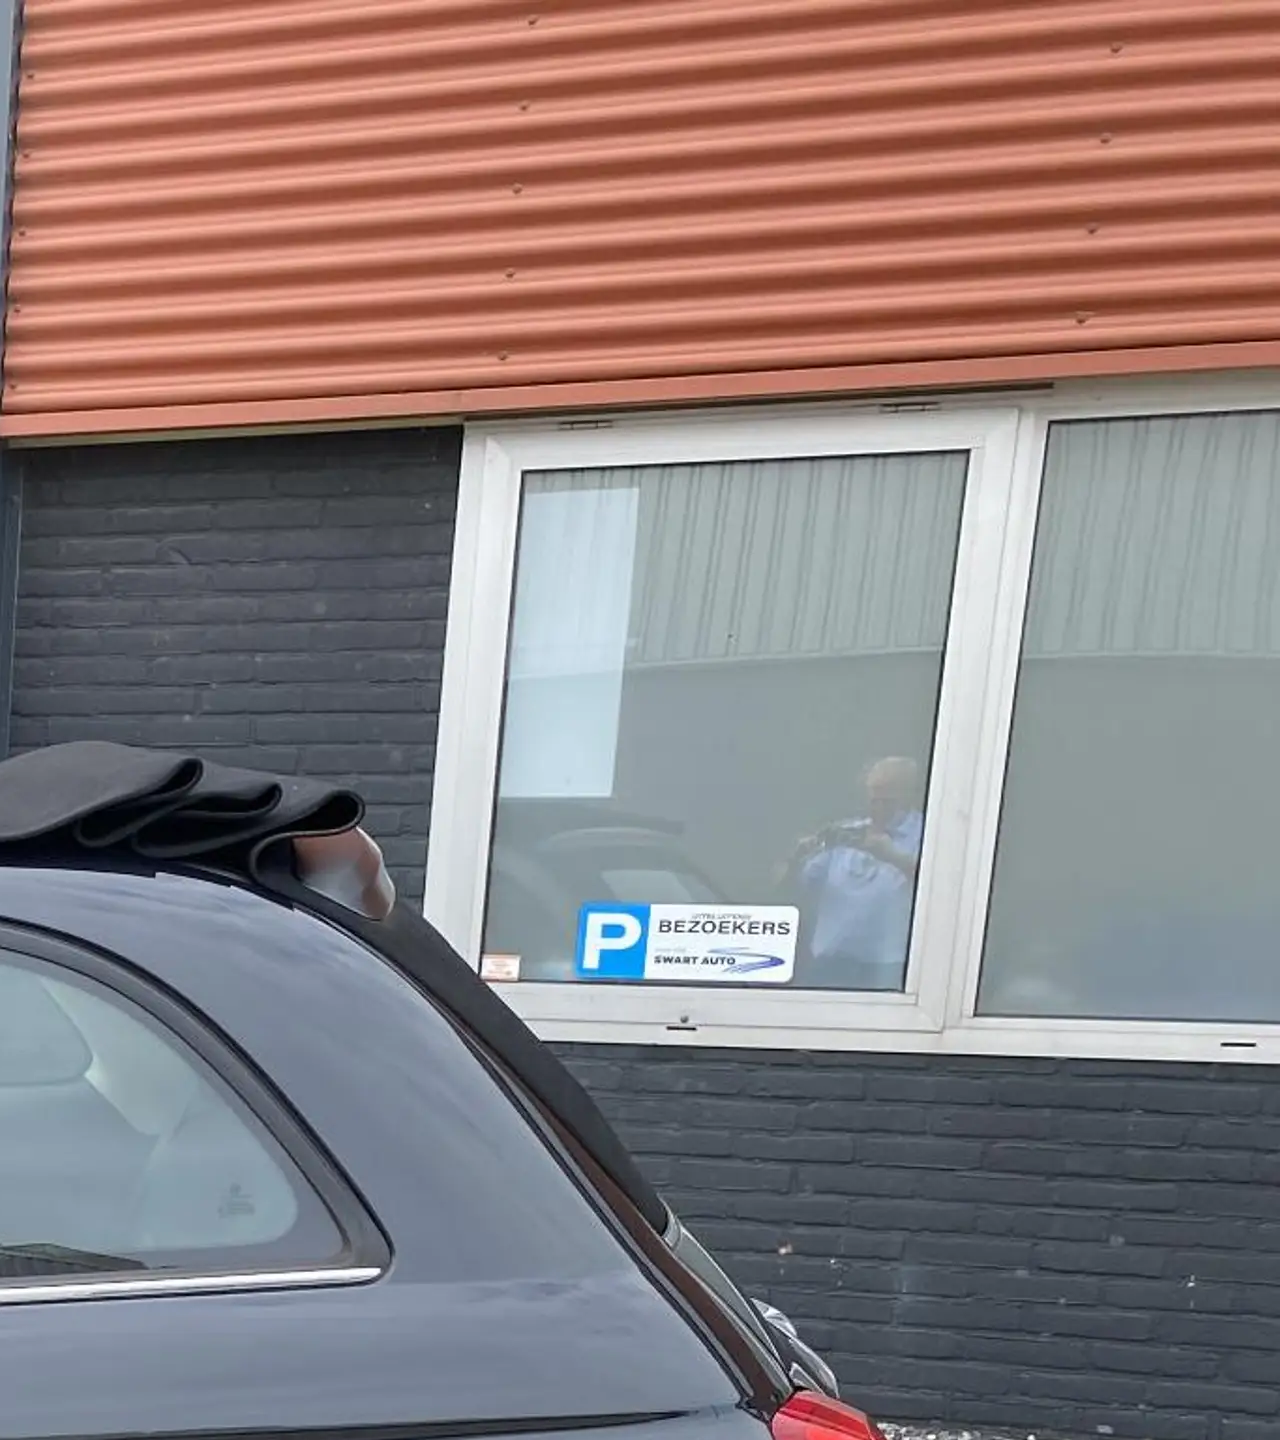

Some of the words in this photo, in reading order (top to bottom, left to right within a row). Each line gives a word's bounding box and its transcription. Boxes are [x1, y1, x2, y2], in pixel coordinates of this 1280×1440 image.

[658, 919, 791, 936] BEZOEKERS
[582, 911, 642, 970] P
[653, 954, 698, 966] SWART
[699, 955, 736, 967] AUTO
